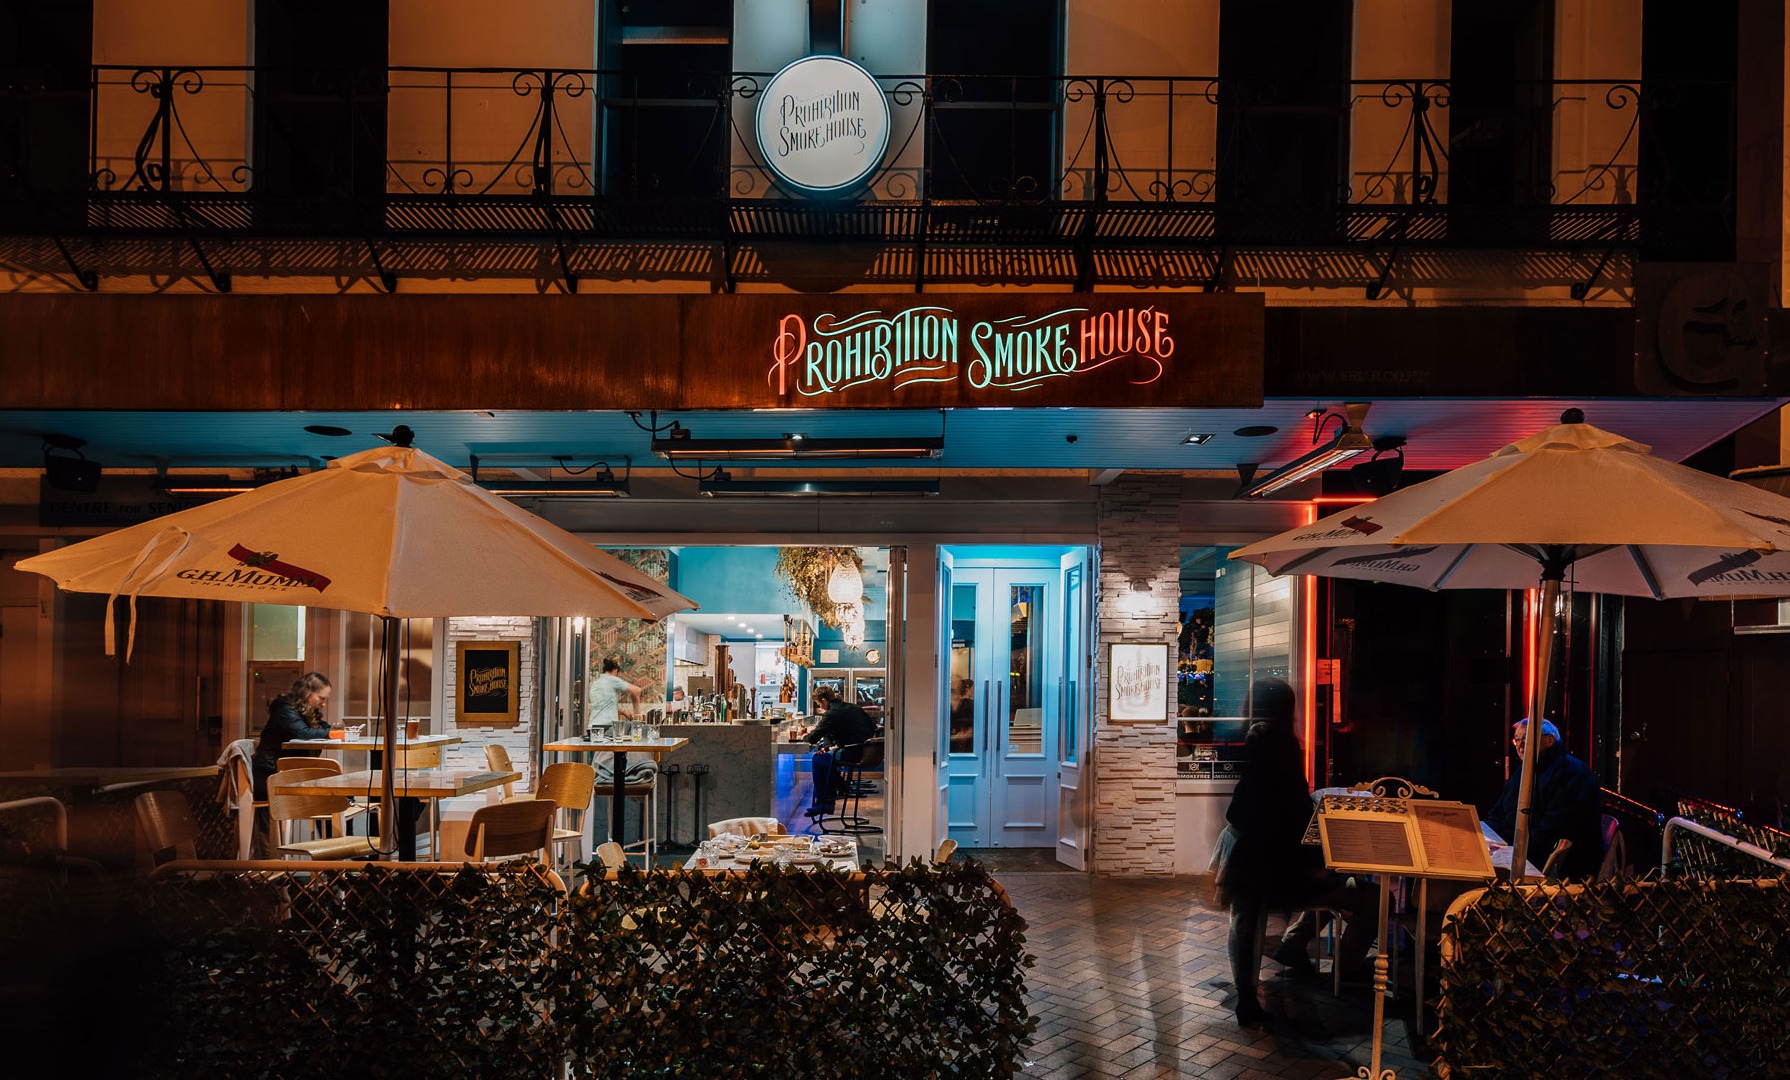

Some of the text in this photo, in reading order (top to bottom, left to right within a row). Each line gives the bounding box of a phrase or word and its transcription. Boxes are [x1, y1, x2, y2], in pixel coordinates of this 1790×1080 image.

[779, 90, 860, 128] PROHIBITION
[767, 307, 958, 396] PROHIBITION
[50, 502, 112, 514] CENTRE
[119, 505, 141, 514] FOR
[190, 580, 289, 592] CHAMPAGNE
